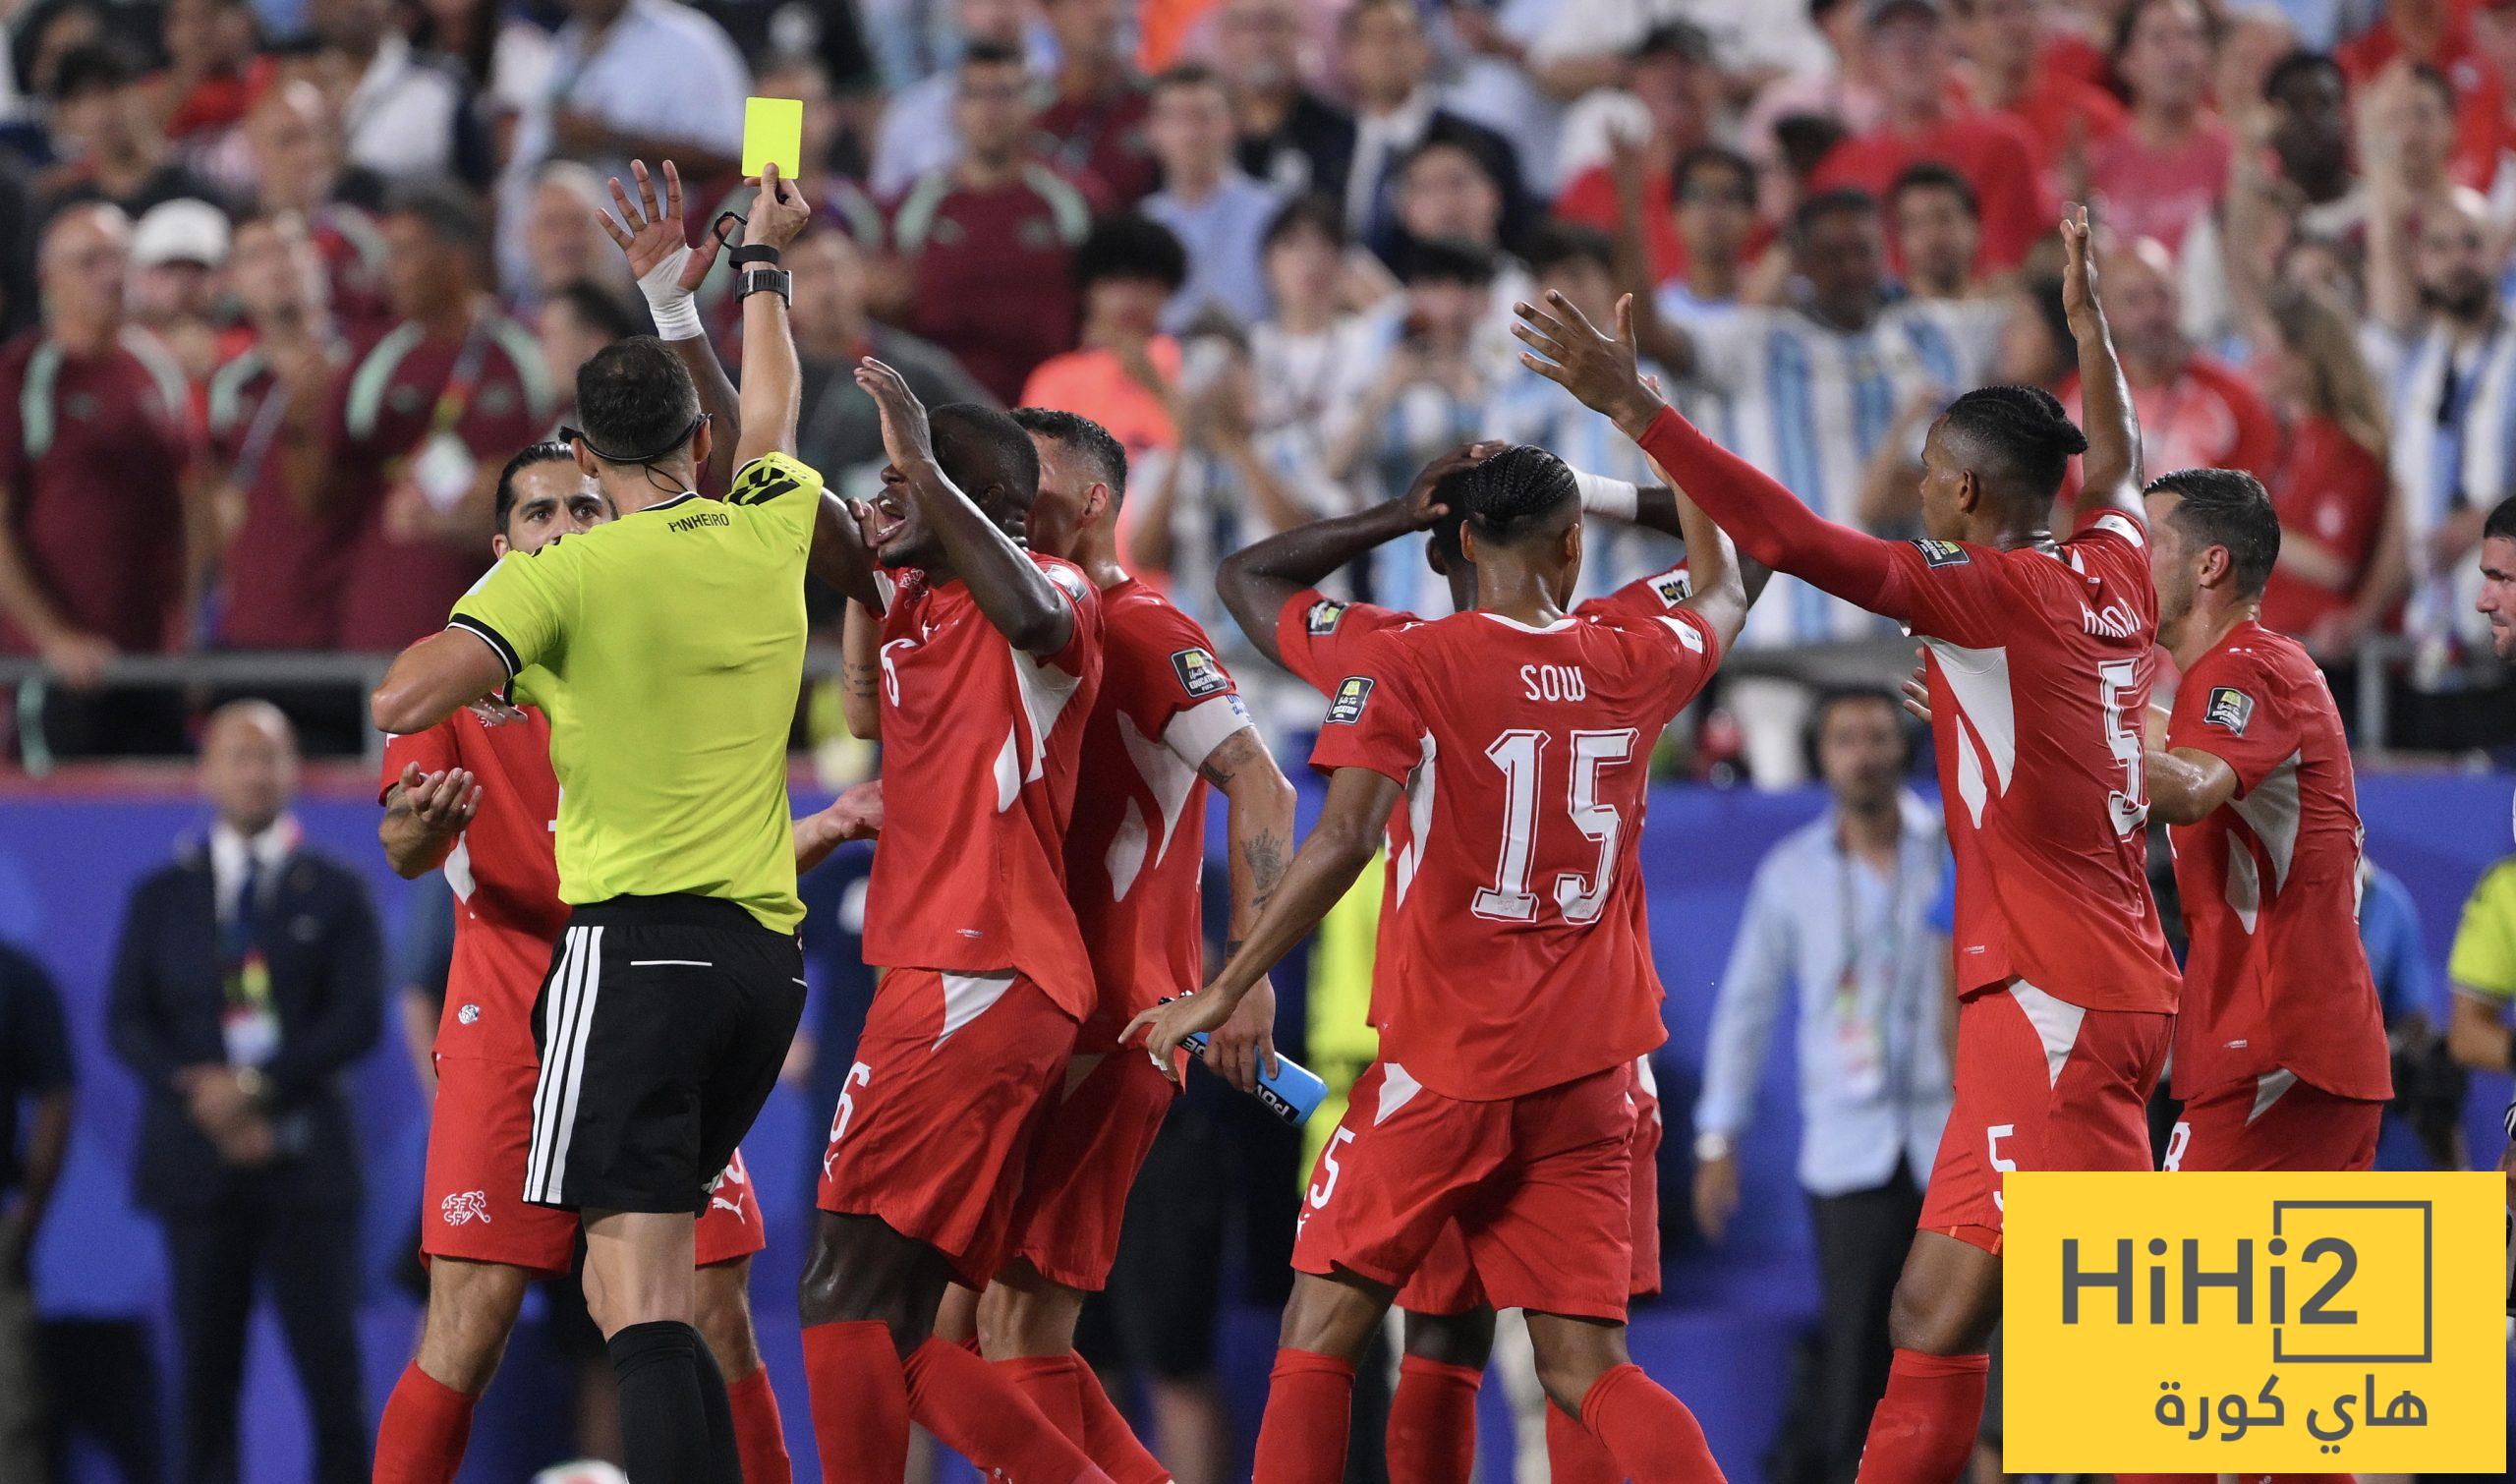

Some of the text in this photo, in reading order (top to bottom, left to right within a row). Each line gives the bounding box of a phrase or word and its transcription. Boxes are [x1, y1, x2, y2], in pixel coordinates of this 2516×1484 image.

[667, 513, 730, 532] PINHEIRO
[1520, 664, 1586, 702] SOW
[2097, 657, 2150, 843] 5
[1471, 727, 1640, 926] 15
[829, 1060, 872, 1144] 6
